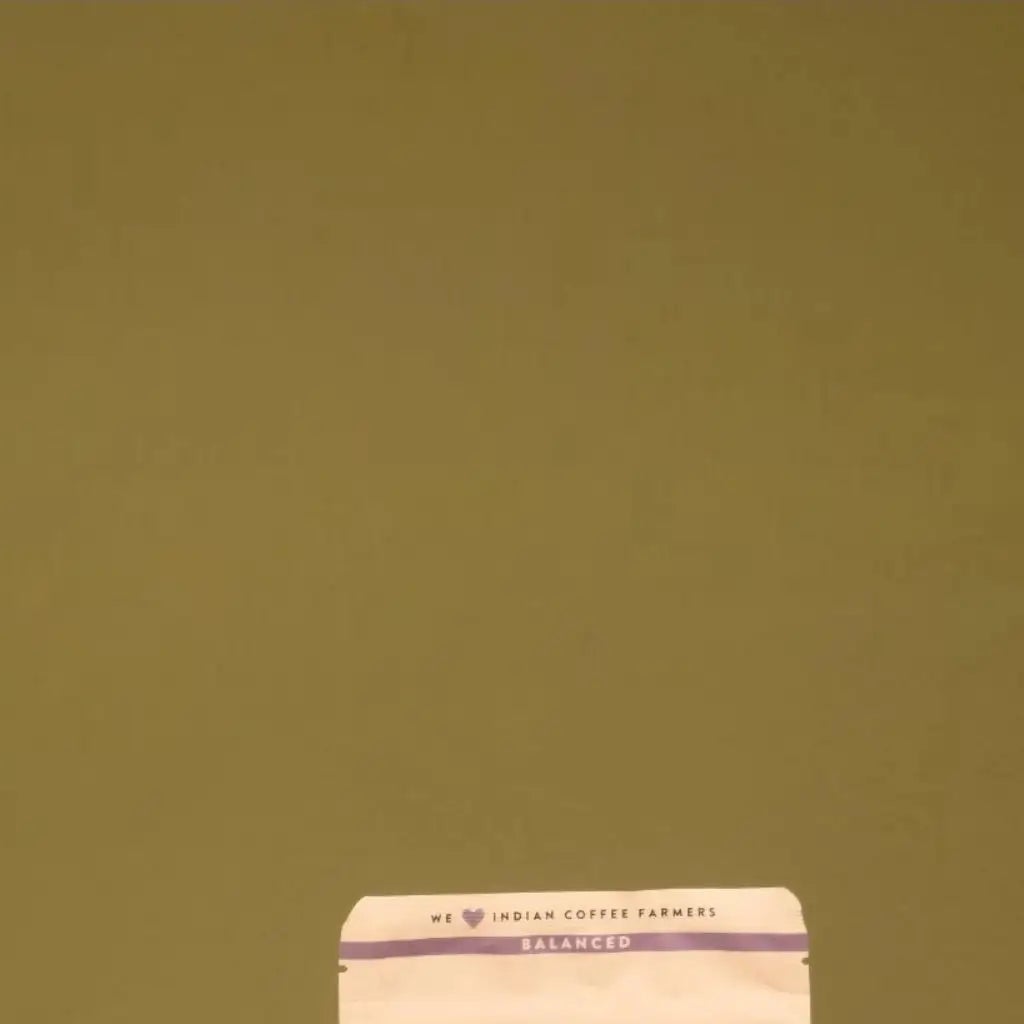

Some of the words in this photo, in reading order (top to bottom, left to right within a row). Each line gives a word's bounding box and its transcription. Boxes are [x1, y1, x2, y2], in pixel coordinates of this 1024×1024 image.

[431, 913, 452, 924] WE
[492, 910, 555, 922] INDIAN
[564, 908, 629, 920] COFFEE
[638, 906, 717, 919] FARMERS
[522, 935, 631, 951] BALANCED
